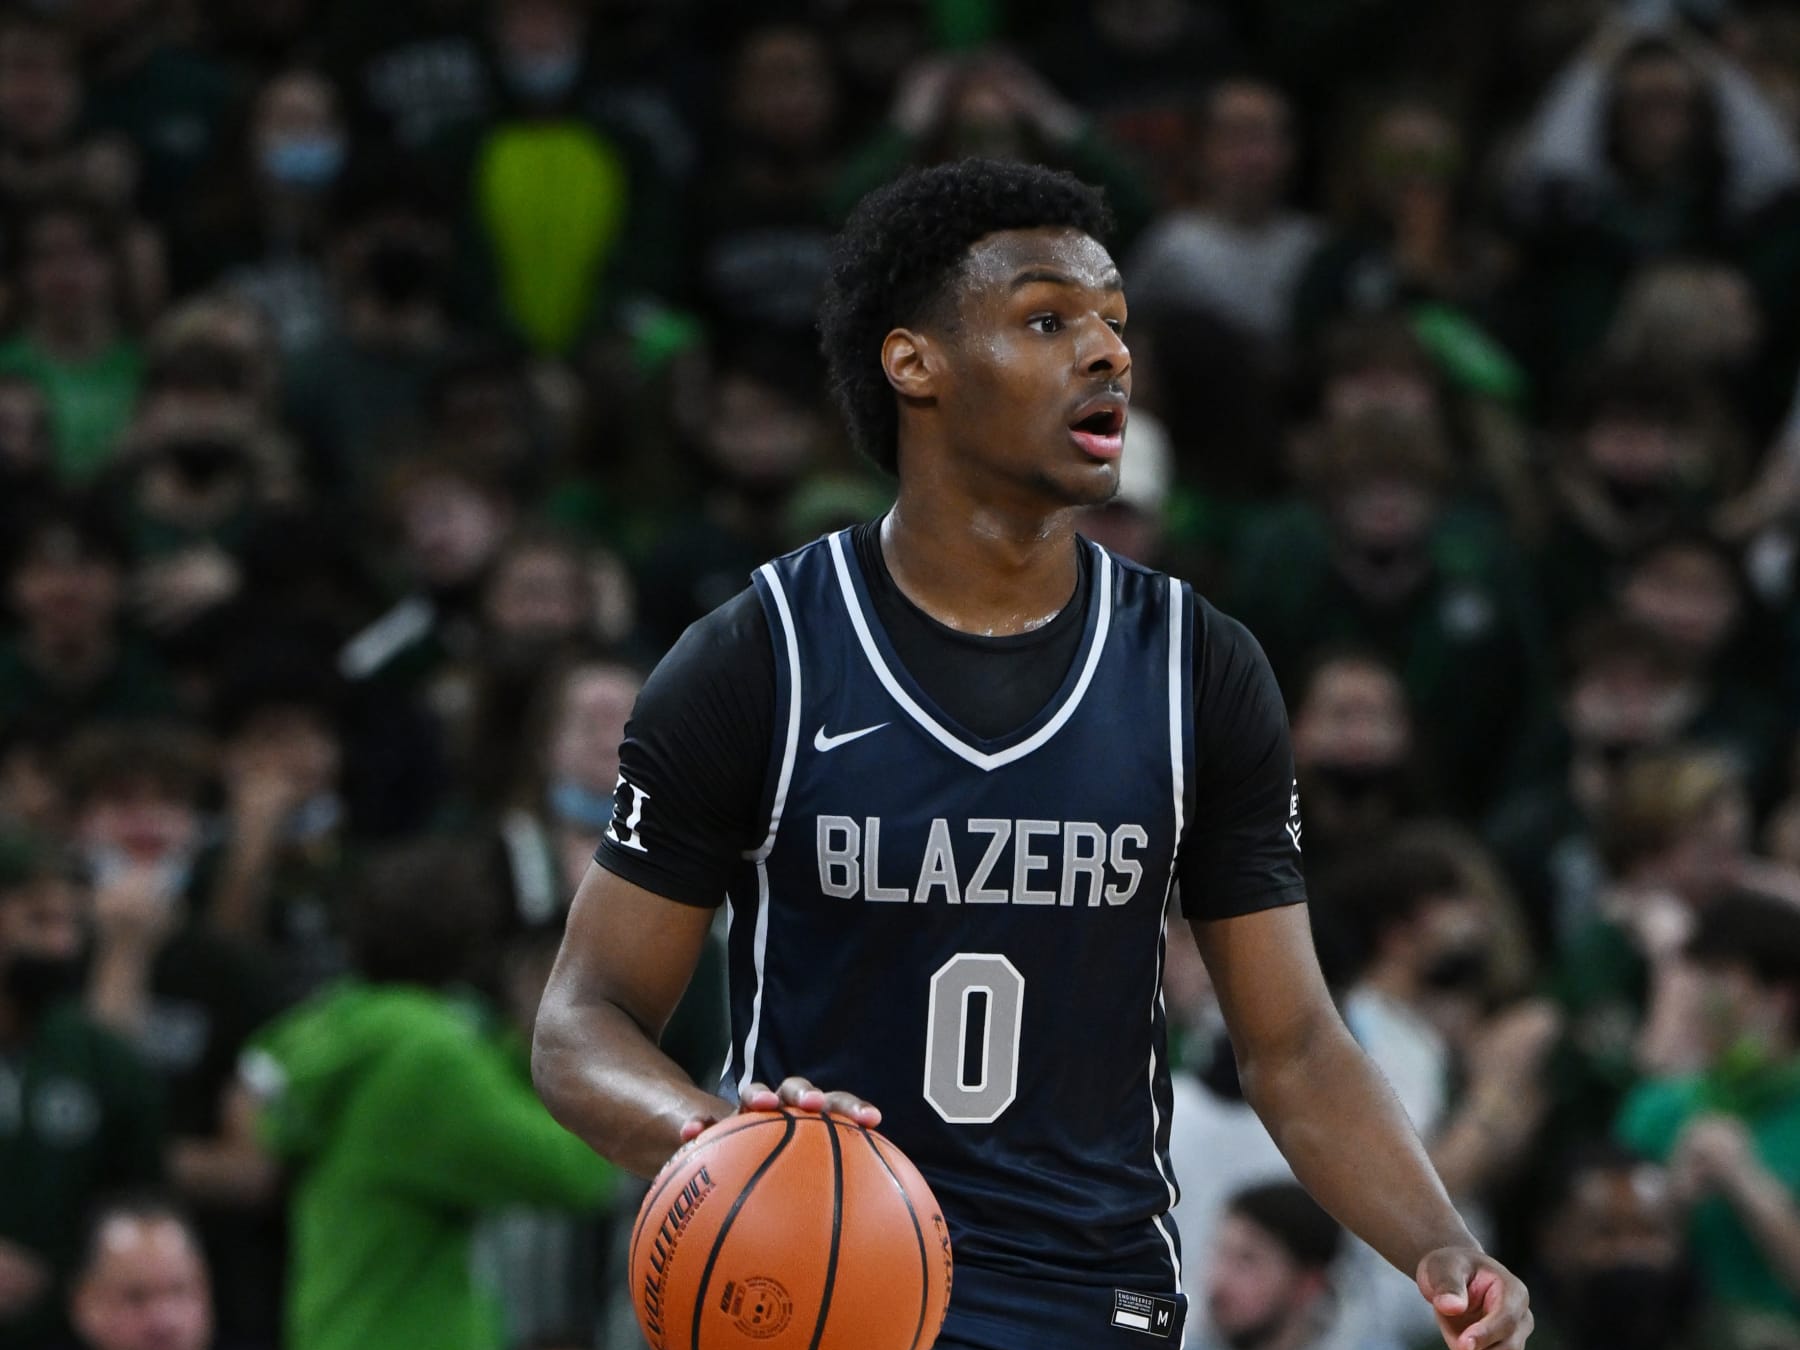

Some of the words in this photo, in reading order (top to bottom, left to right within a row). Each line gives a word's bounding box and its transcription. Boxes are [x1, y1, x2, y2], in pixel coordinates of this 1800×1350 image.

[816, 815, 1149, 906] BLAZERS
[923, 953, 1025, 1124] 0
[1157, 1309, 1169, 1328] M
